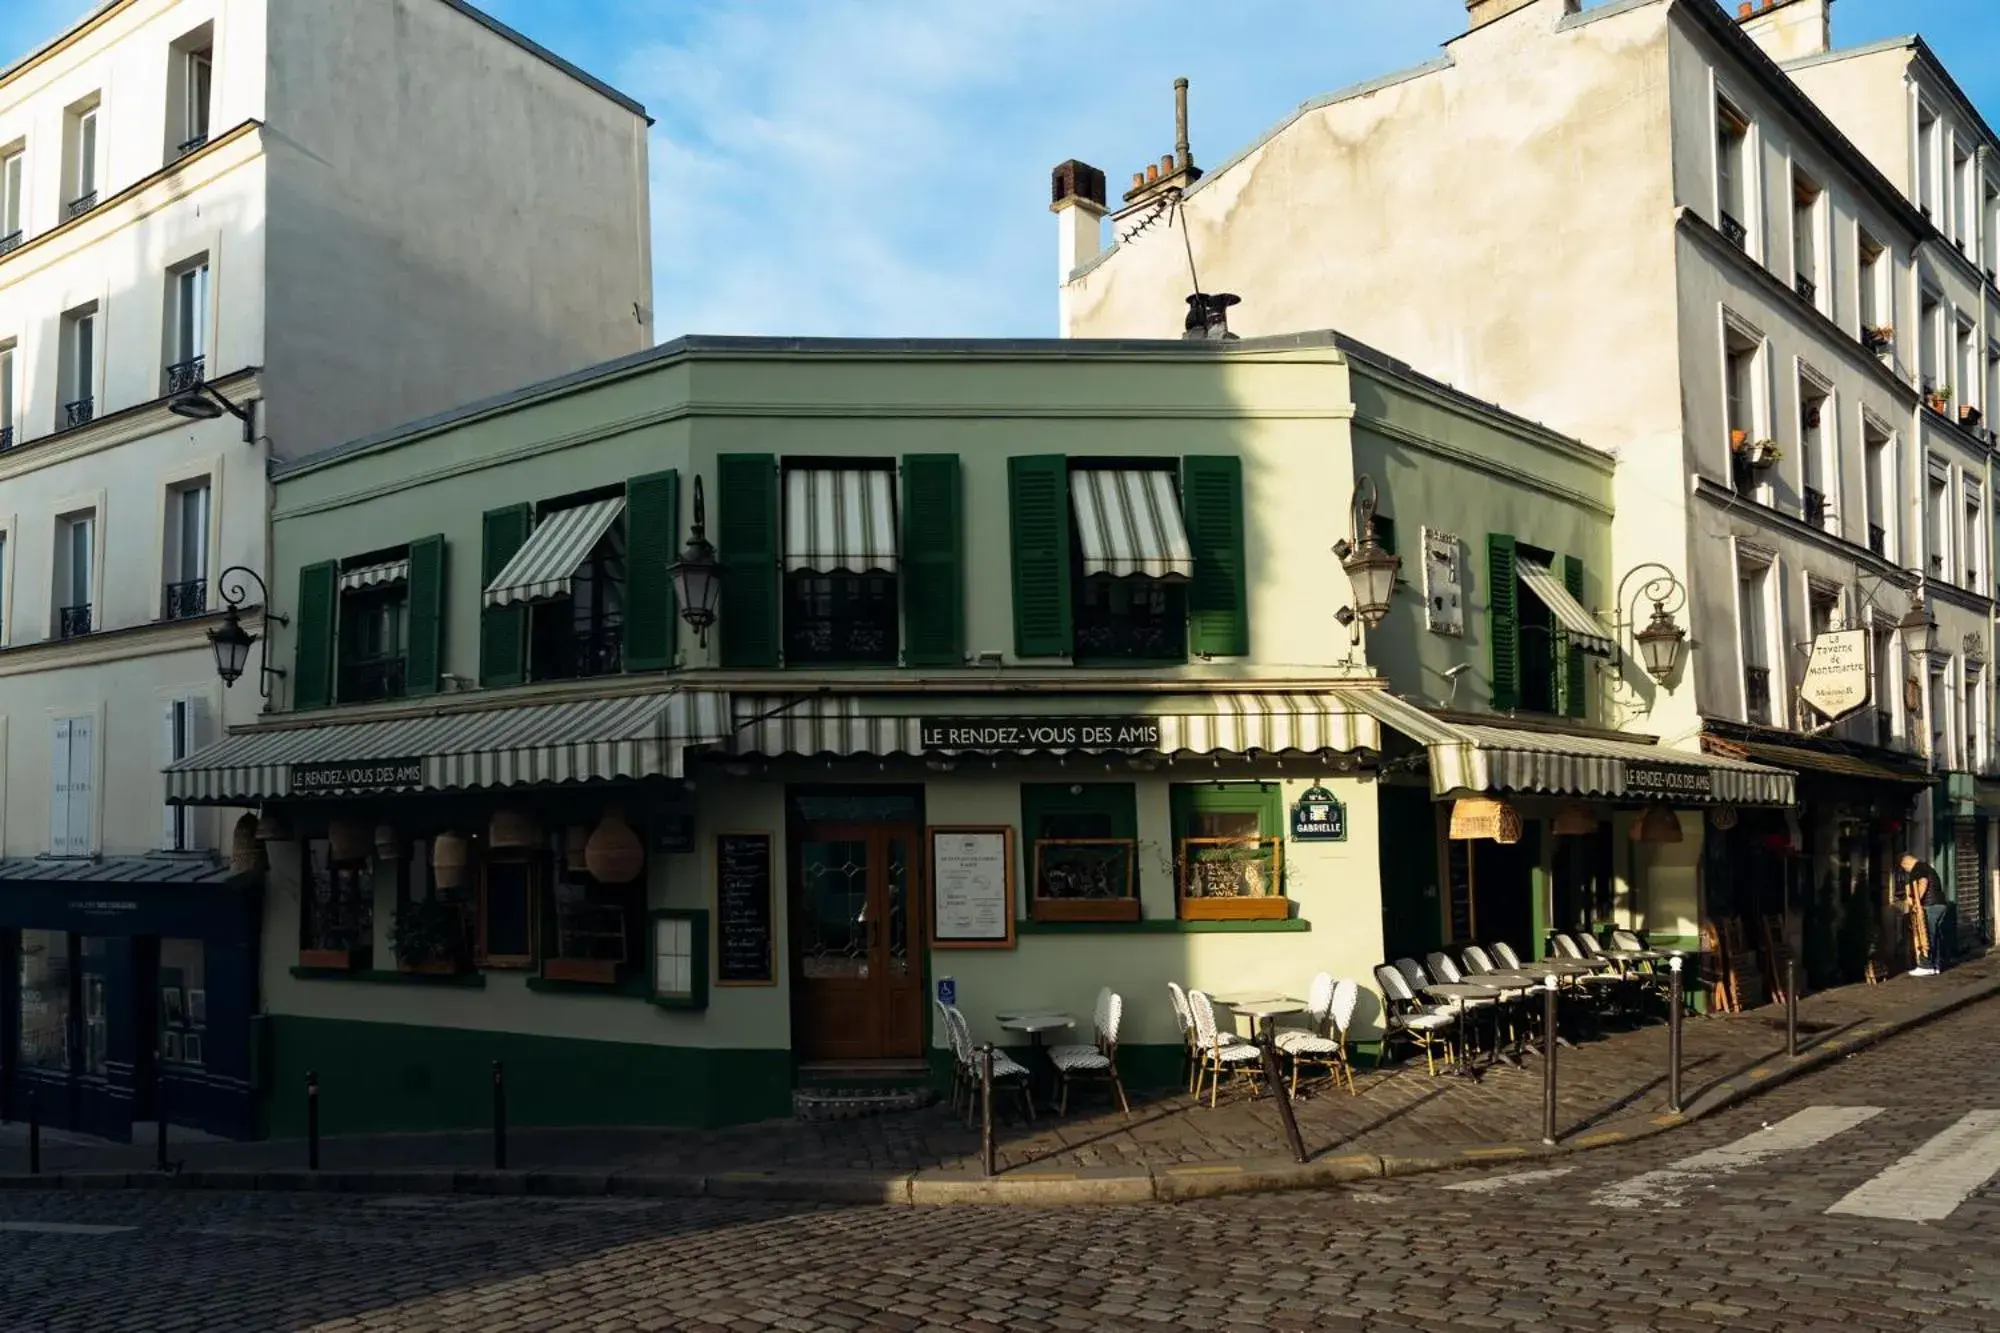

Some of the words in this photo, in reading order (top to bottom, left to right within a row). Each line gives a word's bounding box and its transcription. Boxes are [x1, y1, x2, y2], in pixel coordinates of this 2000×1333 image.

[1816, 645, 1852, 654] Taverne
[1831, 654, 1840, 664] de
[1810, 663, 1864, 675] Montmartre
[924, 728, 943, 745] LE
[950, 727, 1077, 745] RENDEZ-VOUS
[1083, 726, 1113, 743] DES
[1117, 726, 1158, 743] AMIS
[292, 772, 303, 786] LE
[304, 768, 374, 785] RENDEZ-VOUS
[375, 767, 394, 783] DES
[397, 765, 420, 781] AMIS
[1626, 769, 1636, 785] LE
[1636, 769, 1683, 788] RENDEZ-VOUS
[1684, 774, 1695, 789] DES
[1696, 775, 1710, 790] AMIS
[1296, 823, 1341, 833] GABRIELLE
